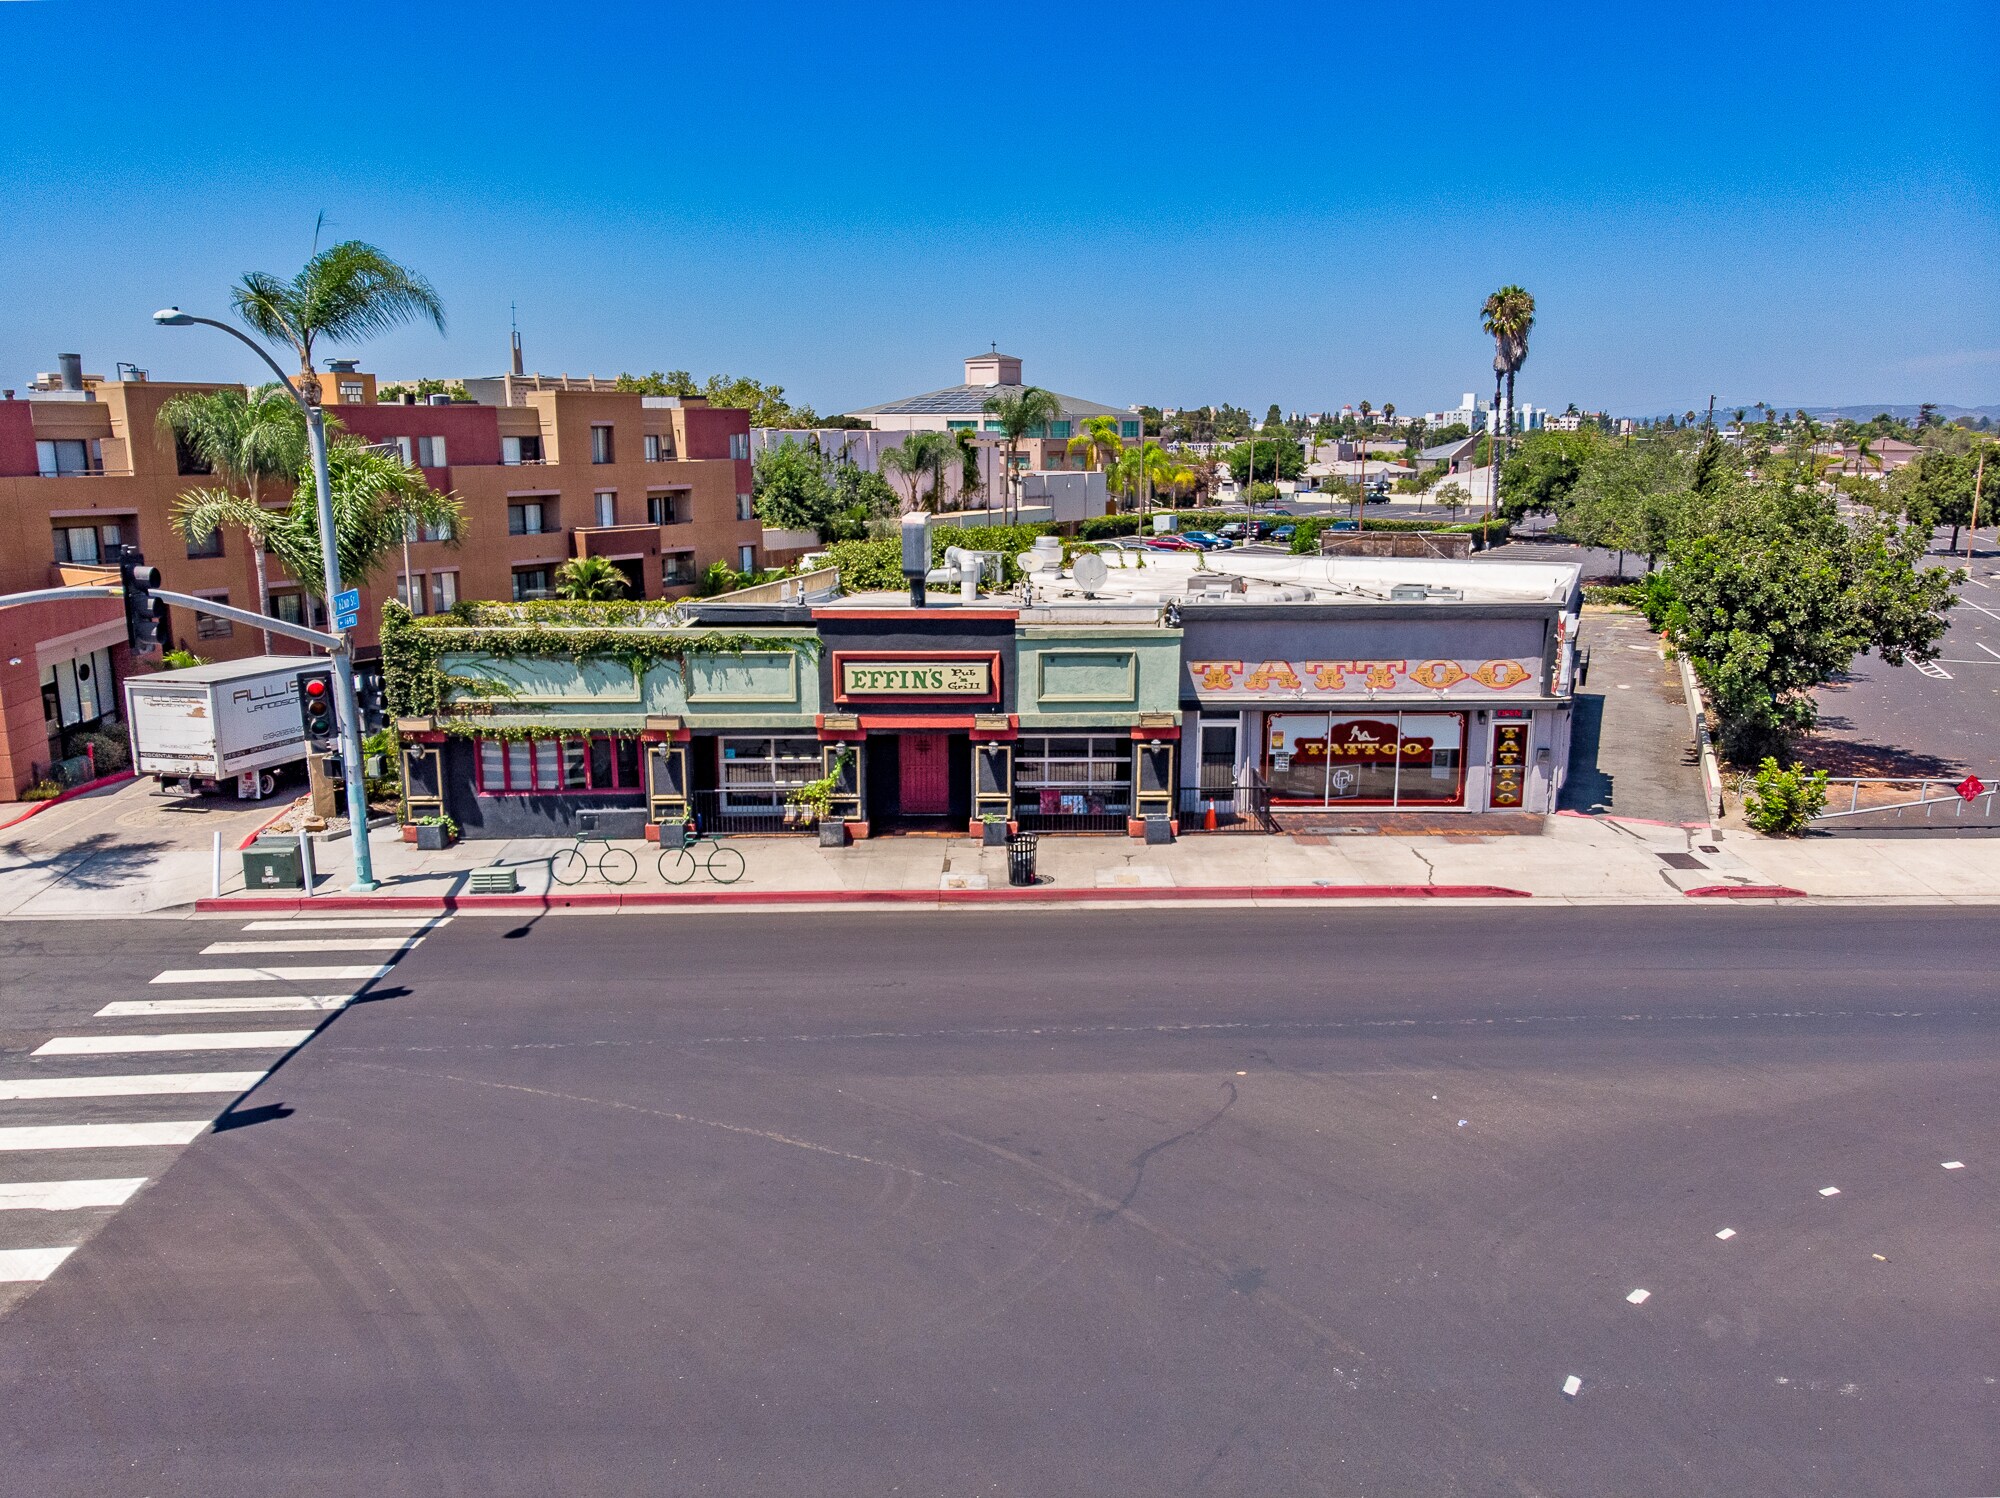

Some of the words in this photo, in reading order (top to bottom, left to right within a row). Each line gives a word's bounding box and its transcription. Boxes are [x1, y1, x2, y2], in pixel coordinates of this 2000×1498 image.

[851, 668, 943, 689] EFFIN'S
[951, 668, 976, 677] Pub
[1192, 659, 1532, 691] TATTOO
[947, 681, 981, 691] Grill
[1497, 709, 1522, 717] OPEN
[1304, 743, 1425, 755] TATTOO
[1495, 727, 1520, 804] TATTOO
